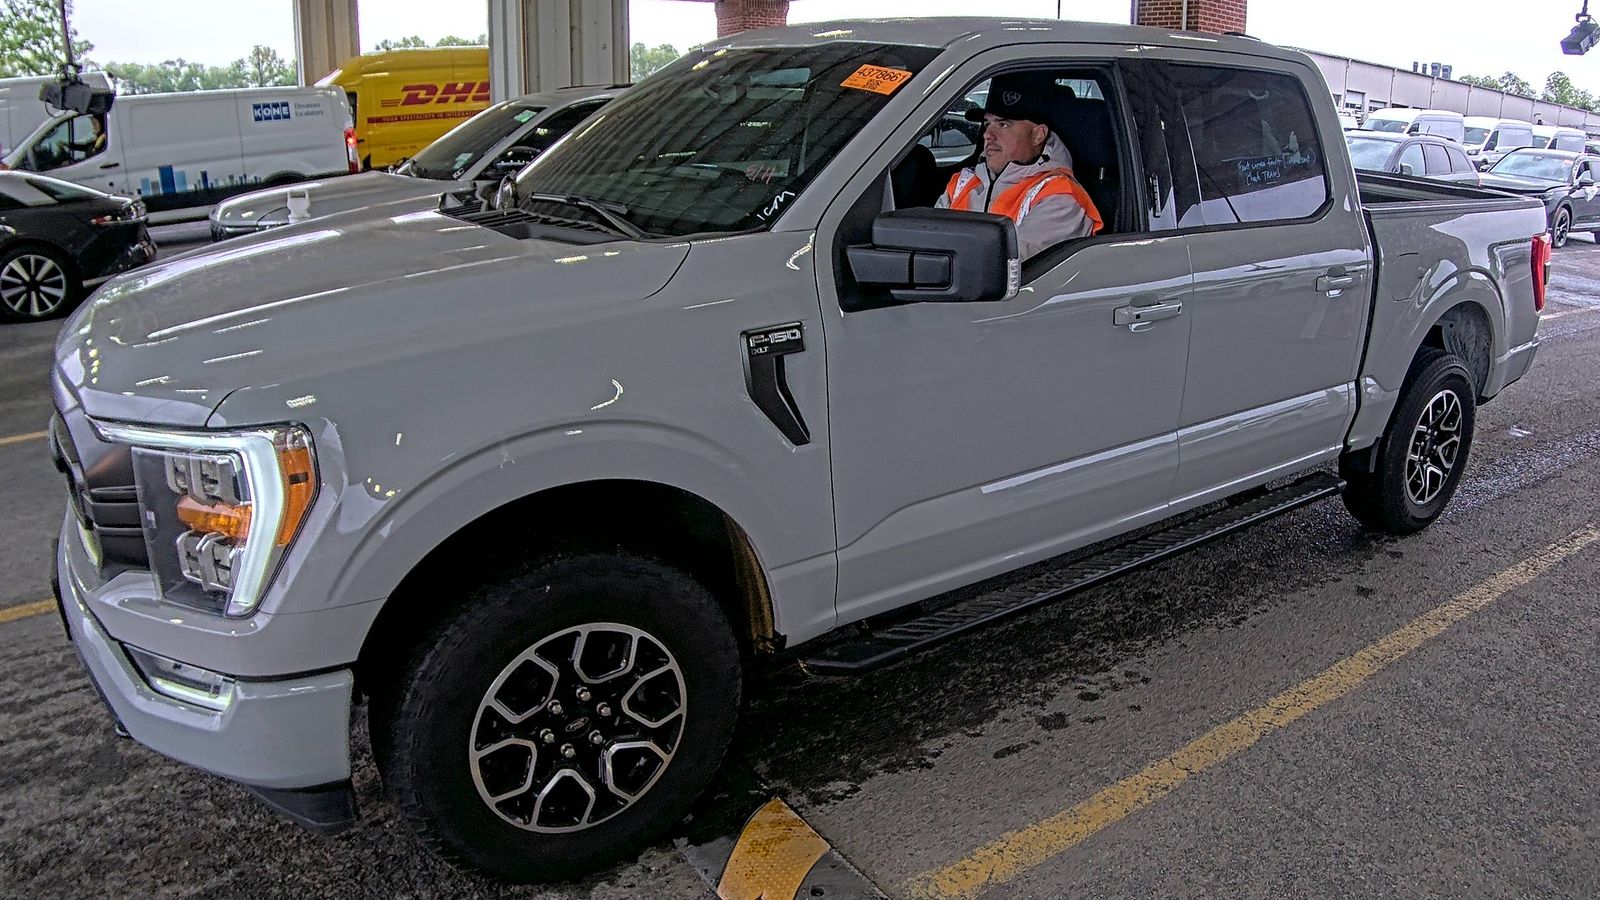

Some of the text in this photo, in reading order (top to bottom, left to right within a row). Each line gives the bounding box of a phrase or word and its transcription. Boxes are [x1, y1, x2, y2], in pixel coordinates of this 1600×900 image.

[857, 67, 908, 83] 4378661
[749, 329, 801, 347] F-150
[751, 346, 769, 355] XLT
